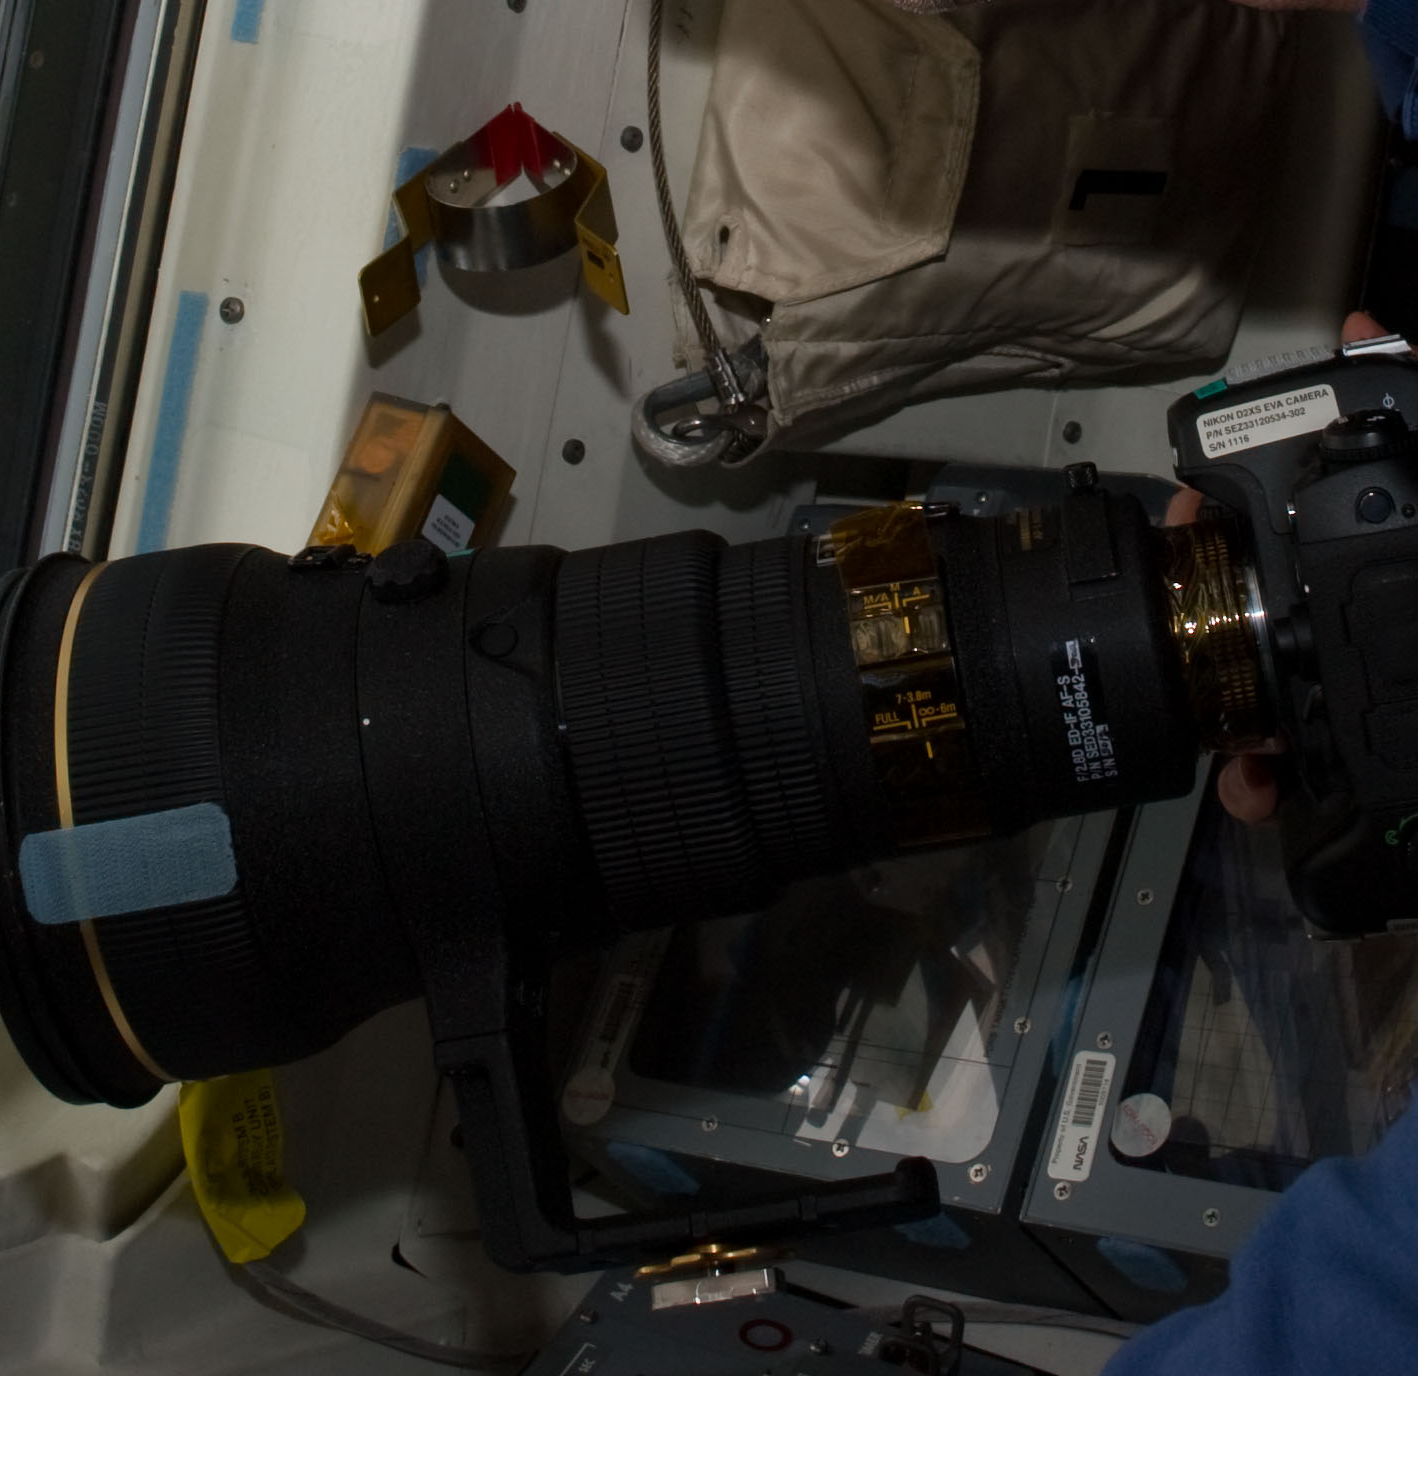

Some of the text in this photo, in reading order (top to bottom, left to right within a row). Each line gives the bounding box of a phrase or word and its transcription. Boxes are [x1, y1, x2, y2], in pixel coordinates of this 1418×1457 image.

[1202, 388, 1330, 429] NIKON D2XS EVA CAMERA
[1206, 407, 1307, 440] P/N SEZ33120534-302
[1208, 440, 1226, 453] S/N
[864, 592, 889, 605] M/A
[1056, 675, 1076, 708] AF-S
[875, 711, 900, 724] FULL
[1063, 712, 1081, 746] ED-IF
[1102, 758, 1119, 777] S/N
[1072, 1135, 1090, 1171] NASA
